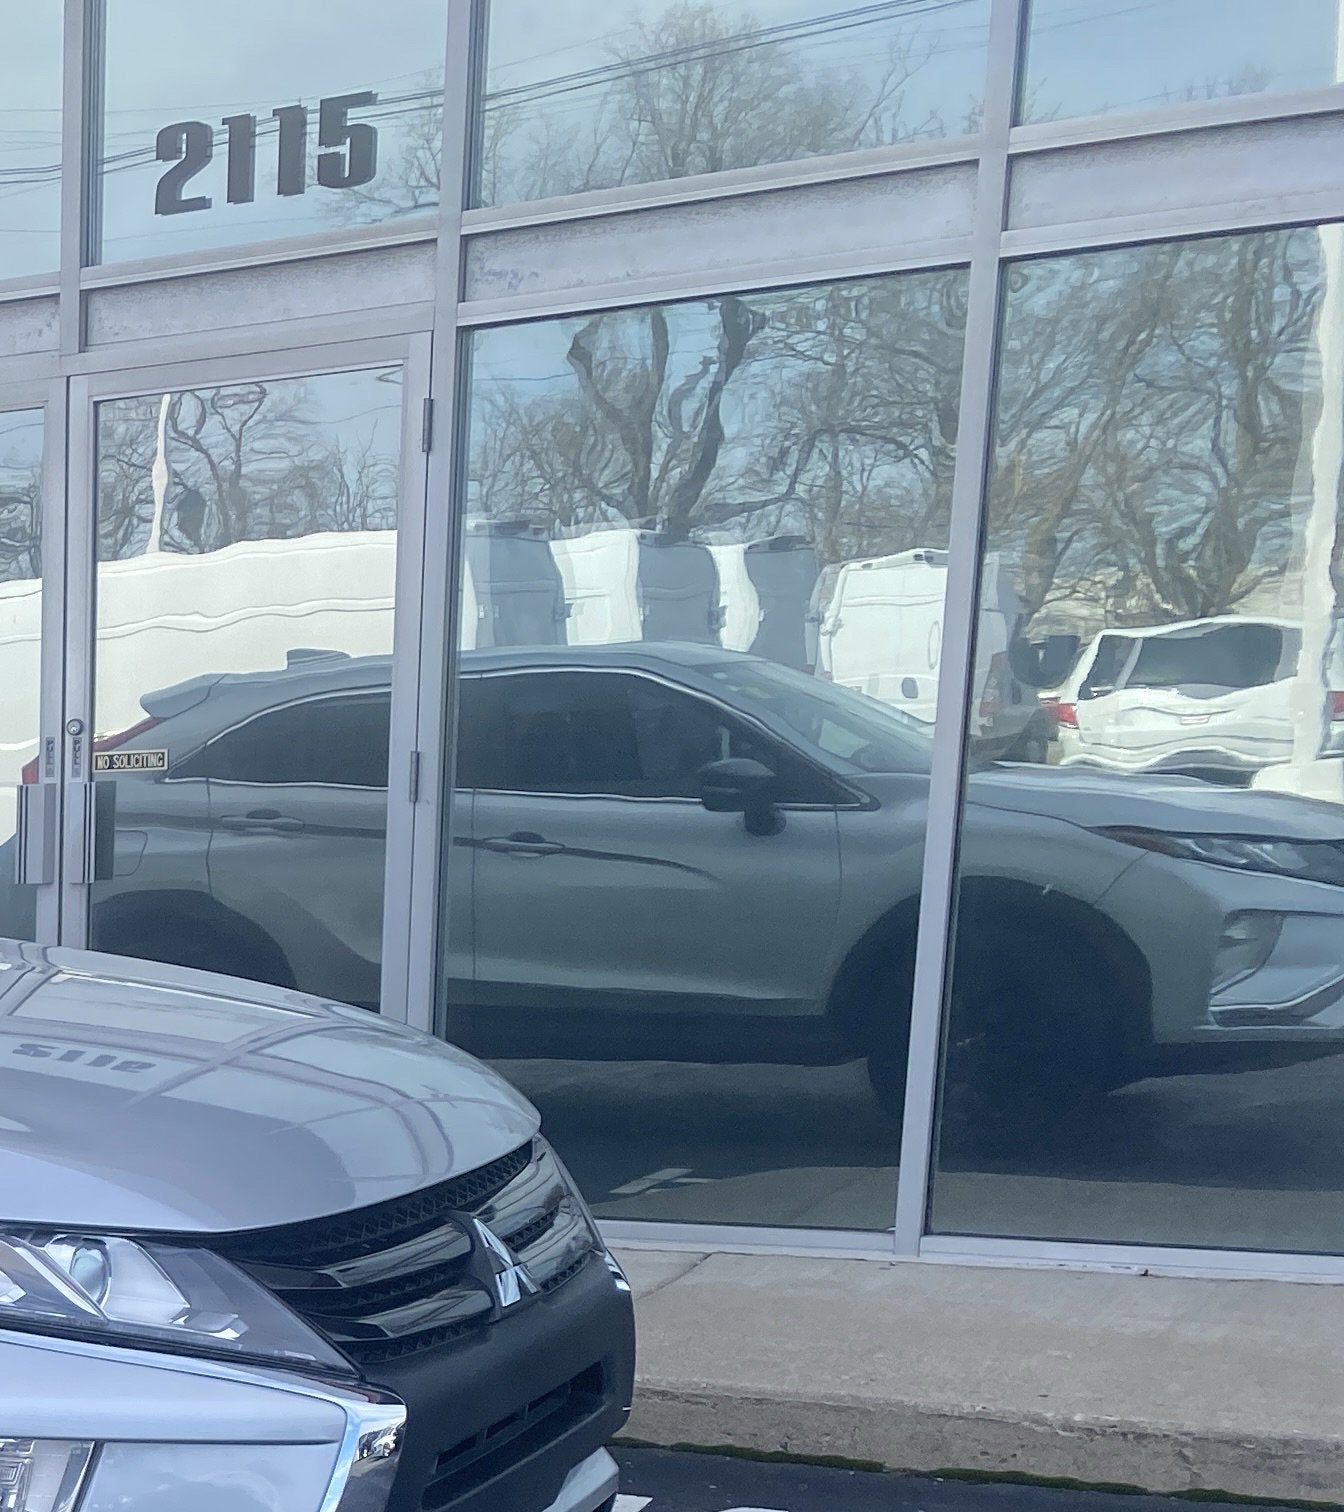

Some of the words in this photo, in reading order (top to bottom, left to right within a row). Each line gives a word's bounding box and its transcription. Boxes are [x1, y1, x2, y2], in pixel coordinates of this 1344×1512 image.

[155, 91, 379, 216] 2115
[73, 740, 81, 765] PULL
[97, 755, 109, 769] NO
[113, 753, 163, 768] SOLICITING
